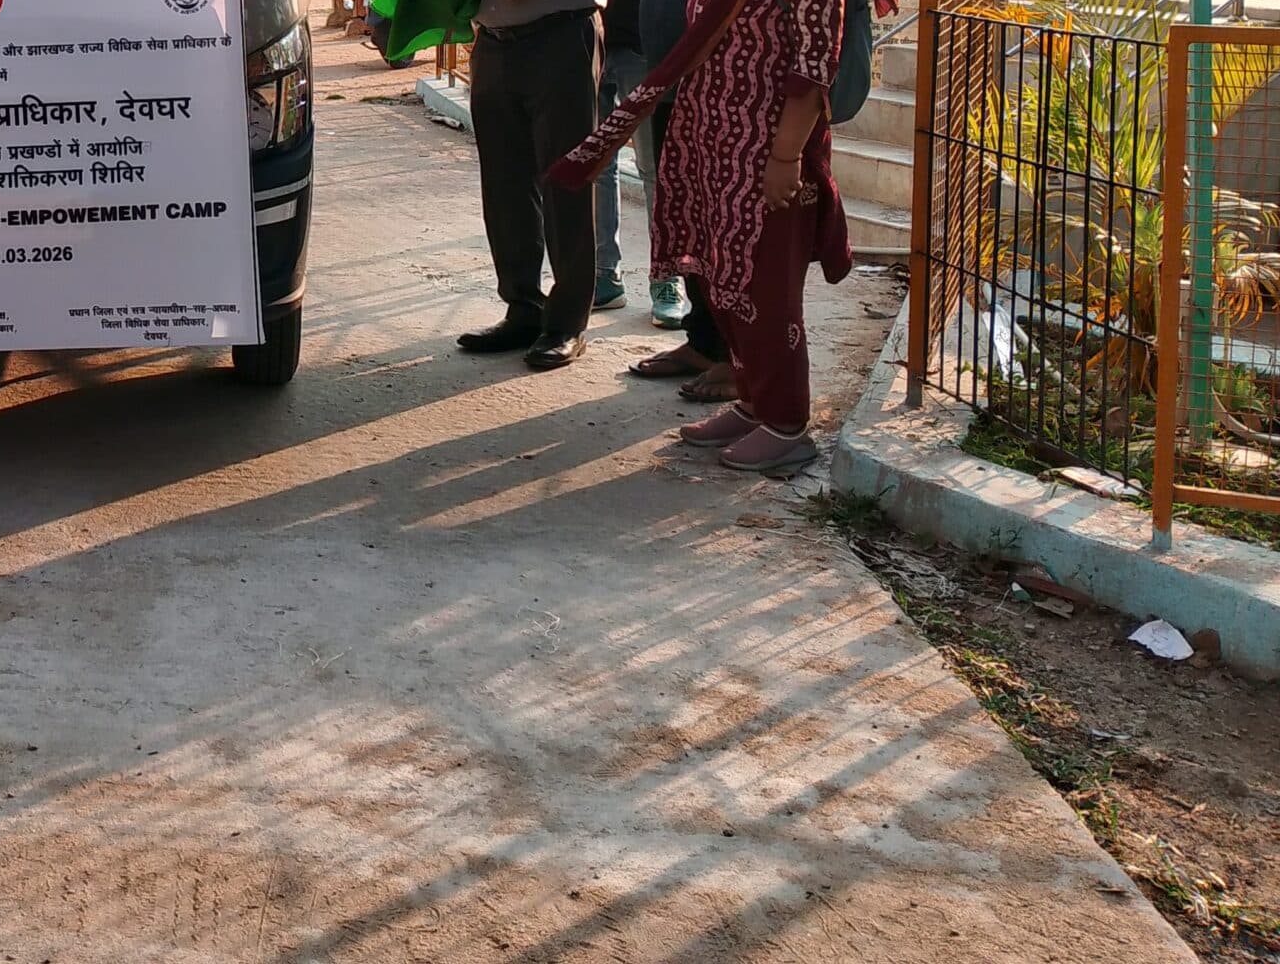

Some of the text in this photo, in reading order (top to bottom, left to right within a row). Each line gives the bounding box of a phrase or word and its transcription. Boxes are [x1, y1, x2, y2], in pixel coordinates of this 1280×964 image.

[2, 42, 24, 58] और
[26, 42, 74, 57] झारखण्ड
[78, 41, 104, 54] राज्य
[108, 38, 143, 53] विधिक
[146, 36, 169, 51] सेवा
[171, 34, 217, 50] प्राधिकार
[220, 33, 233, 48] के
[116, 90, 192, 122] देवघर
[7, 139, 62, 161] प्रखण्डों
[67, 138, 80, 158] में
[89, 160, 146, 185] शिविर
[166, 201, 227, 220] CAMP
[92, 306, 114, 316] जिला
[101, 318, 122, 329] जिला
[125, 317, 150, 329] विधिक
[153, 316, 170, 327] सेवा
